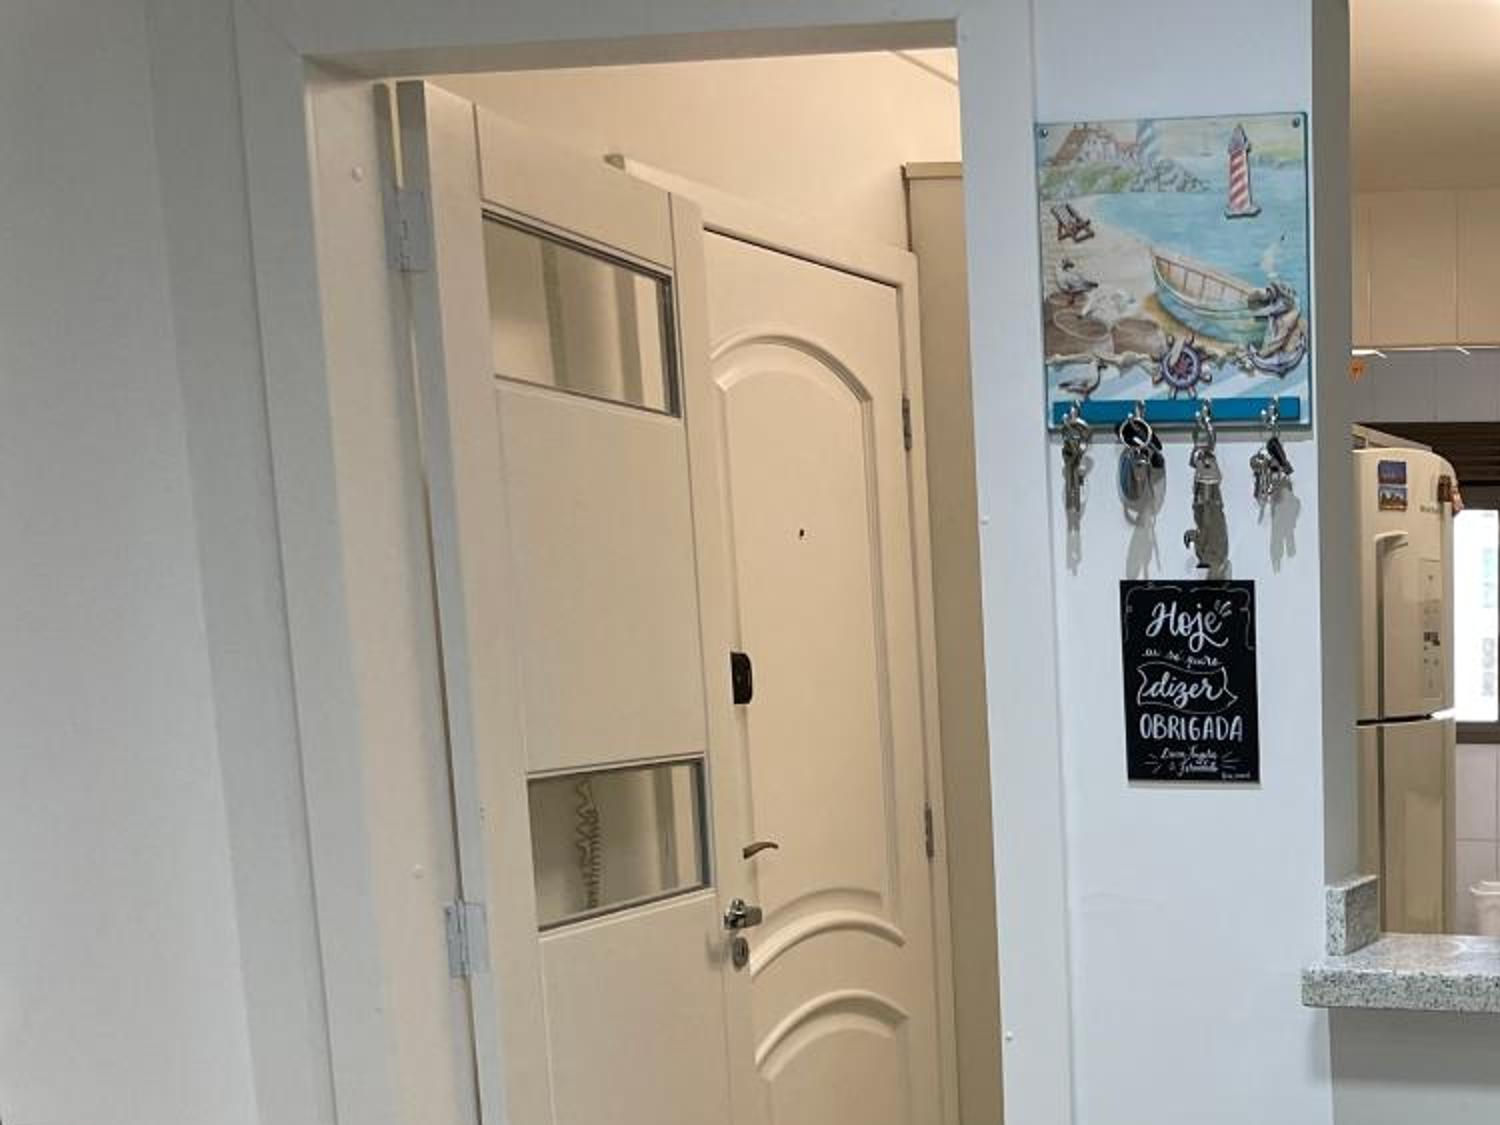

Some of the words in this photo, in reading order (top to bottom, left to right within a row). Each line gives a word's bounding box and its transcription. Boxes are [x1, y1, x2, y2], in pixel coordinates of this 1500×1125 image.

[1146, 601, 1229, 653] Hoje
[1141, 671, 1223, 709] dizer
[1140, 713, 1243, 742] OBRIGADA
